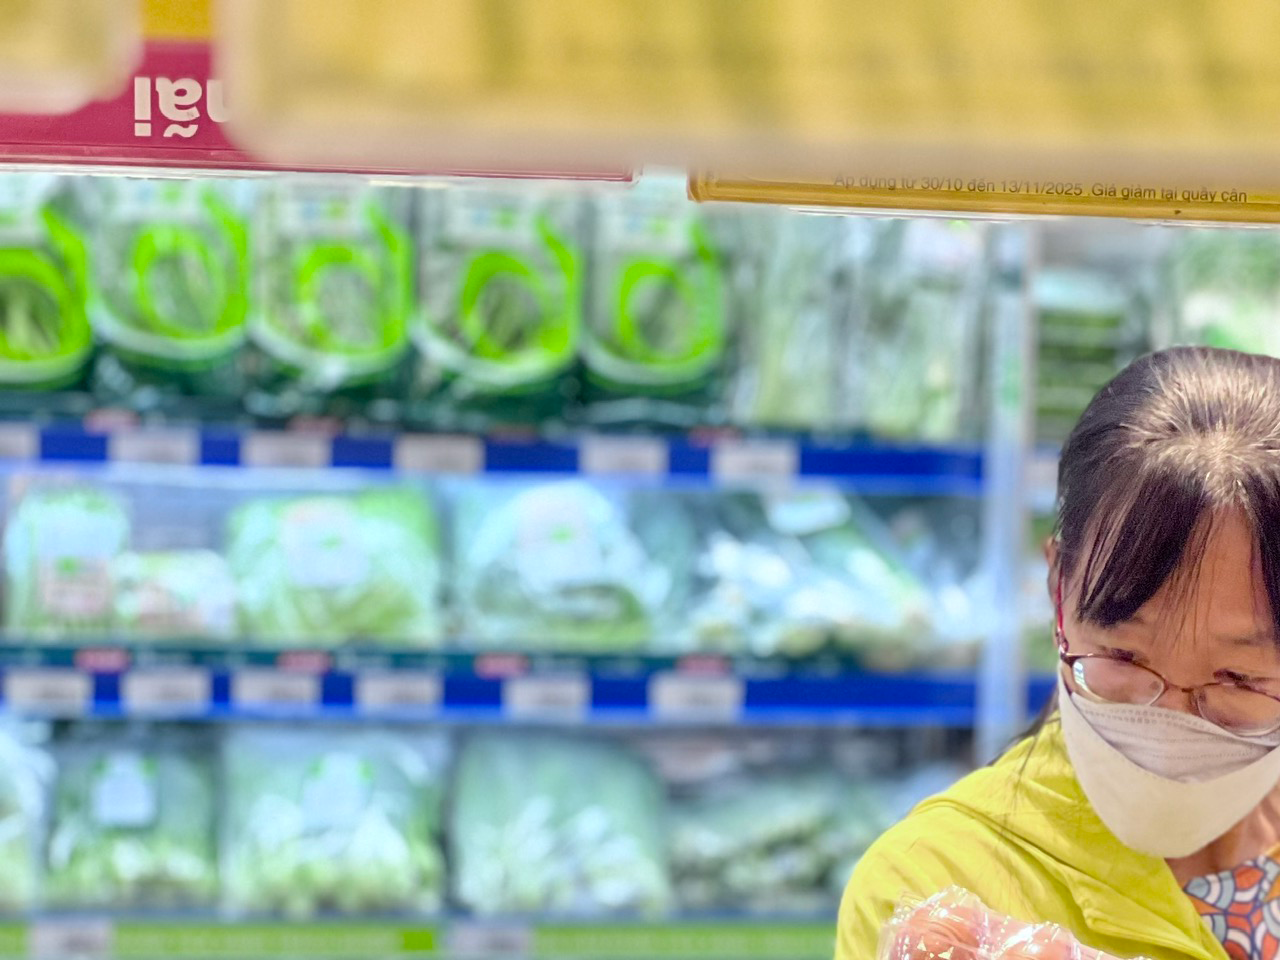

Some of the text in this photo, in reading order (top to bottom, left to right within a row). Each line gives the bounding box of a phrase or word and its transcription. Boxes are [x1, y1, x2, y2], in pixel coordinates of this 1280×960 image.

[859, 175, 896, 190] dụng
[921, 176, 963, 192] 30/10
[1001, 179, 1083, 196] 13/11/2025
[1121, 184, 1156, 200] giảm
[1162, 186, 1178, 201] tại
[1221, 188, 1247, 203] cân
